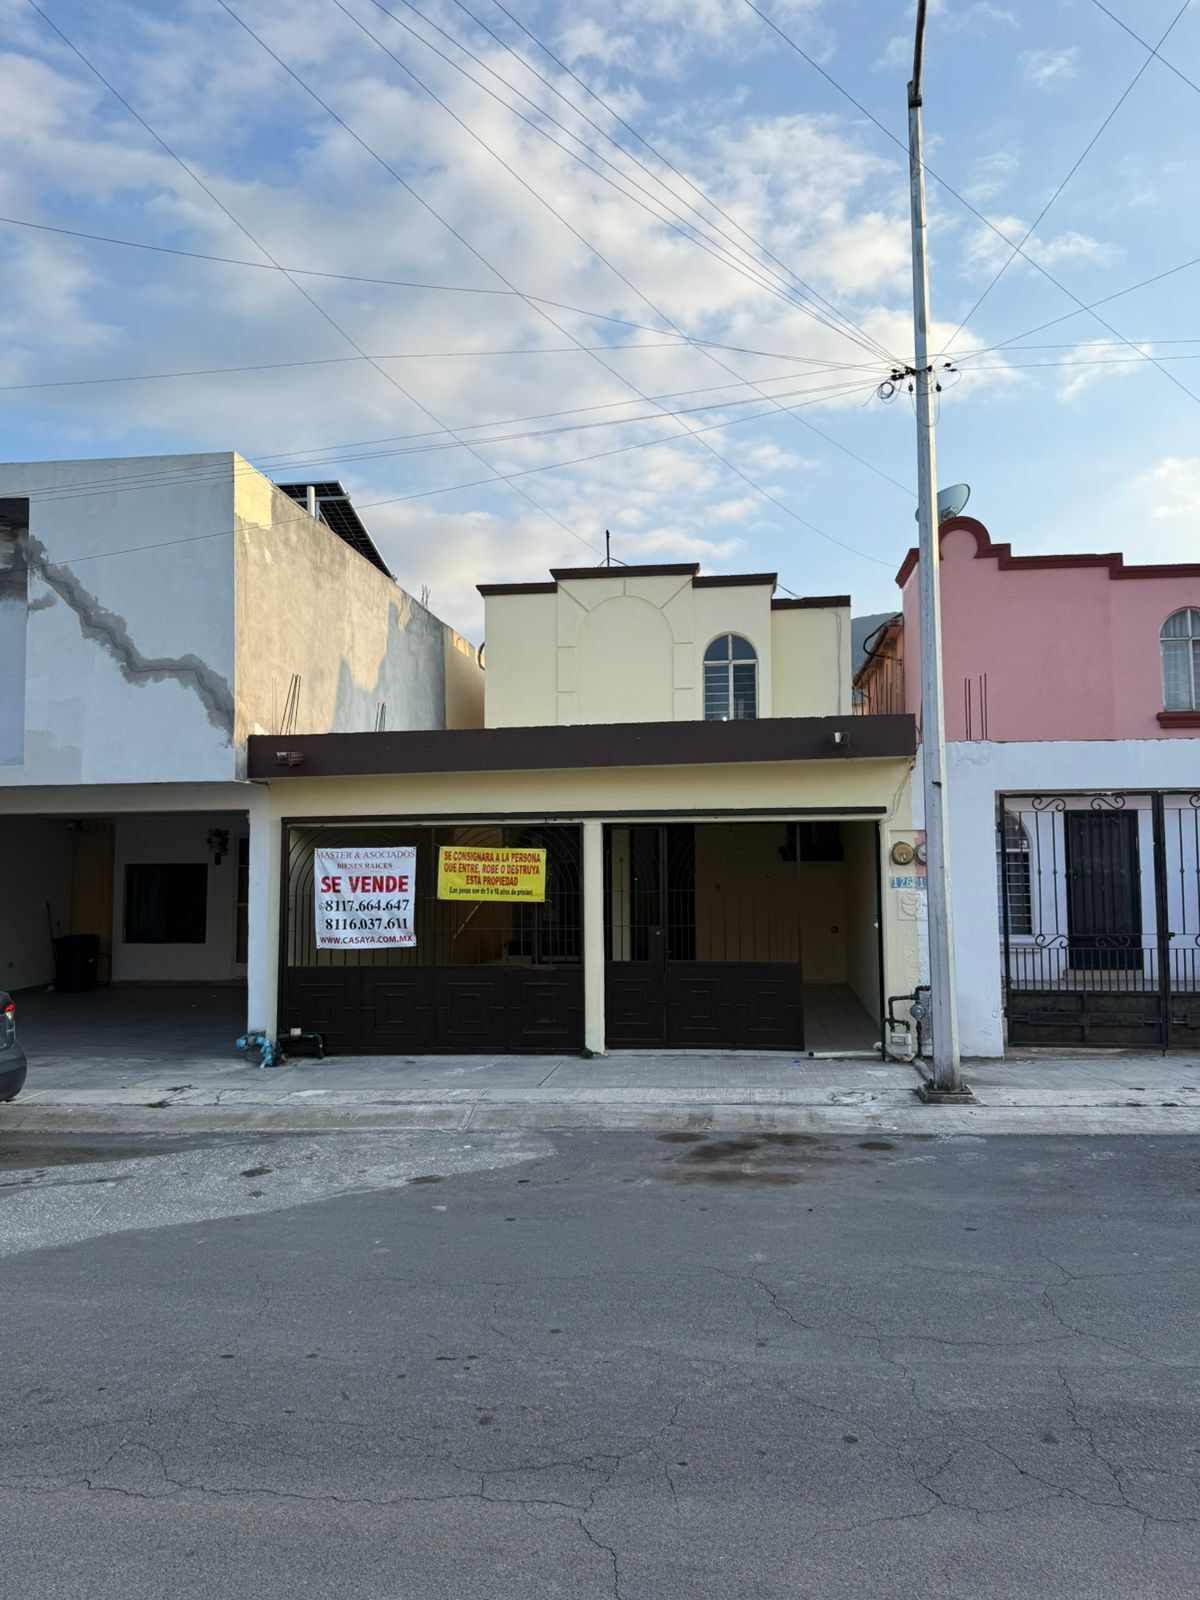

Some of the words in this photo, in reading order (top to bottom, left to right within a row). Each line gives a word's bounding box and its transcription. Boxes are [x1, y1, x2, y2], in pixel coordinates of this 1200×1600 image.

[316, 851, 352, 859] MASTER
[363, 850, 416, 858] ASOCIADOS
[444, 852, 452, 860] SE
[453, 851, 494, 862] CONSIGNARA
[496, 853, 500, 862] A
[502, 853, 509, 862] LA
[512, 853, 540, 863] PERSONA
[444, 863, 457, 872] QUE
[482, 864, 498, 874] ROBE
[500, 864, 506, 874] O
[506, 865, 540, 874] DESTRUYA
[321, 876, 342, 893] SE
[349, 876, 408, 892] VENDE
[466, 876, 482, 884] ESTA
[482, 876, 518, 886] PROPIEDAD
[894, 878, 912, 887] 126
[325, 900, 409, 912] 8117.664.647
[326, 918, 408, 930] 8116.037.611
[320, 935, 412, 944] WWW.CASAYA.COM.MX
